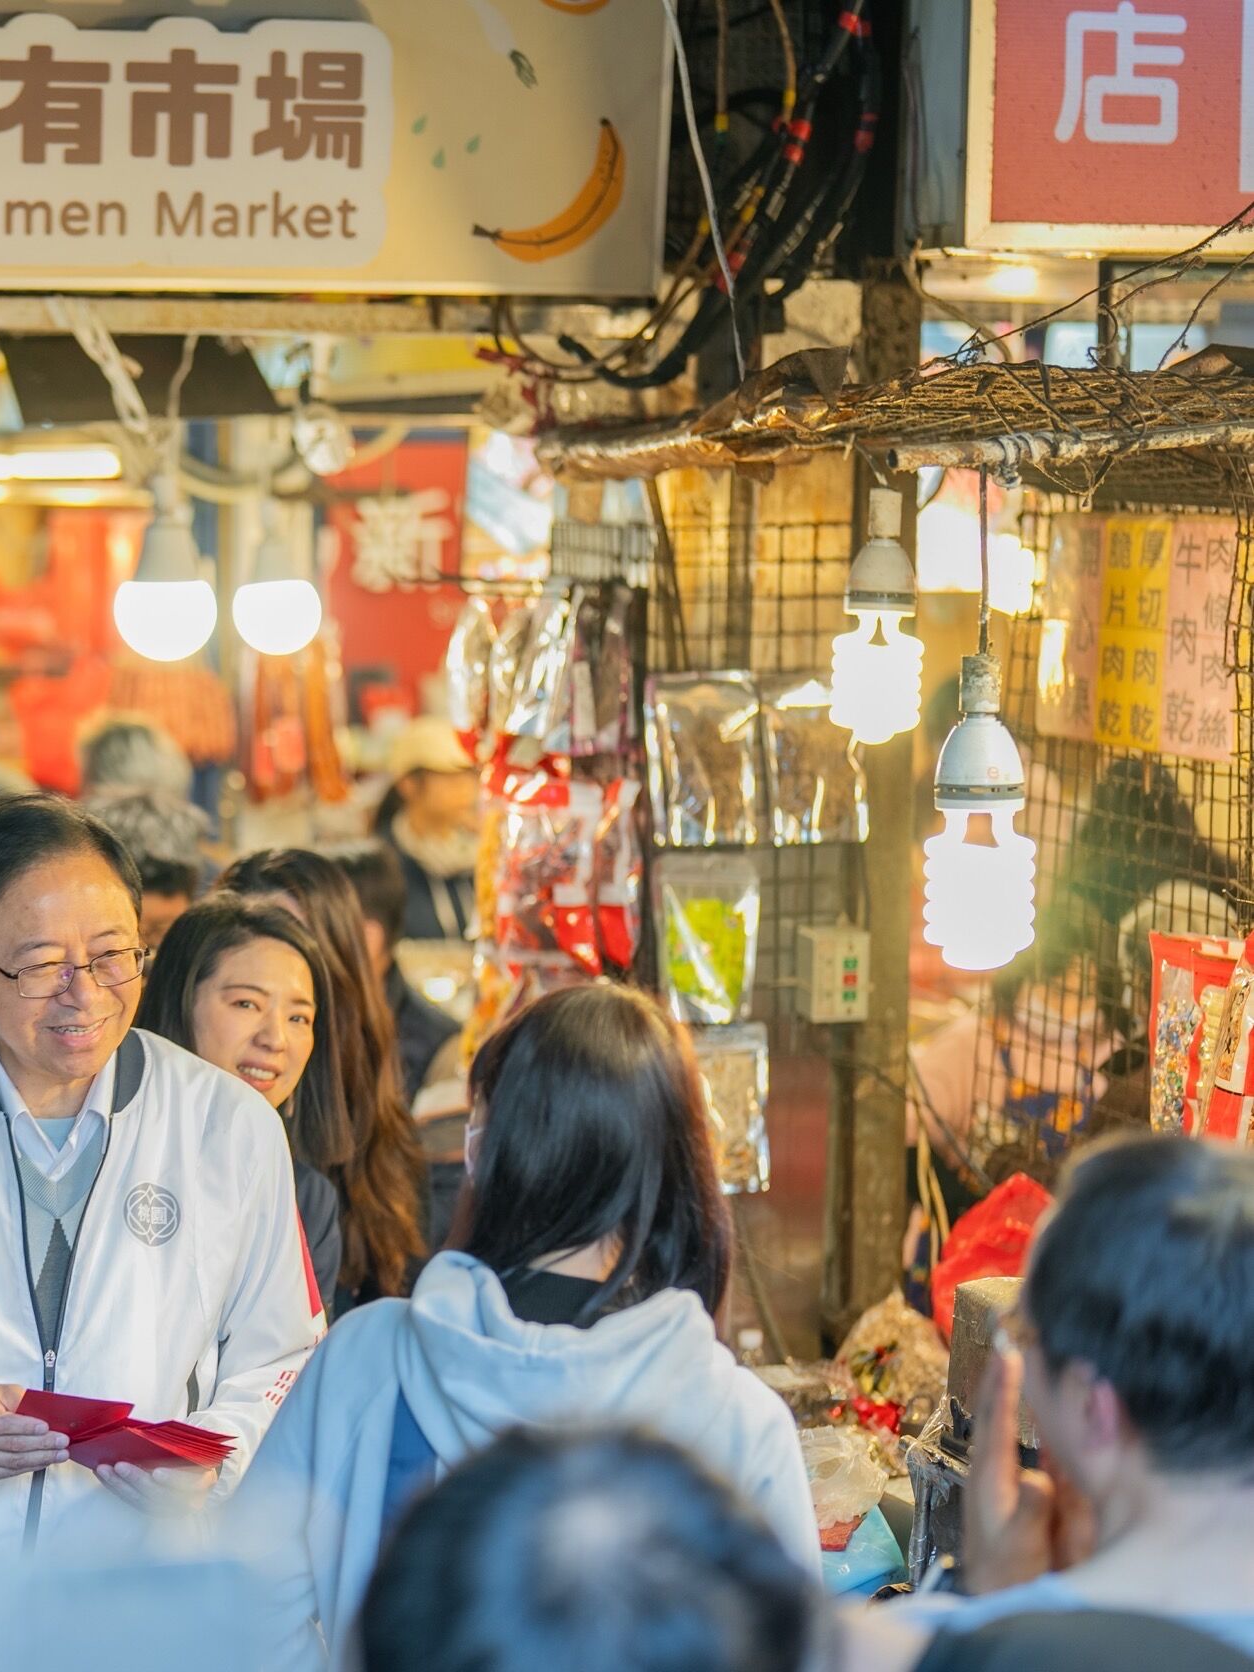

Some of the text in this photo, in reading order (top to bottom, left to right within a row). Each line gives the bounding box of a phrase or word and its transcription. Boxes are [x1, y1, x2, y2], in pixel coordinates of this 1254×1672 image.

[1054, 1, 1187, 145] 店
[155, 189, 358, 240] Market
[1165, 533, 1201, 743] 牛肉乾
